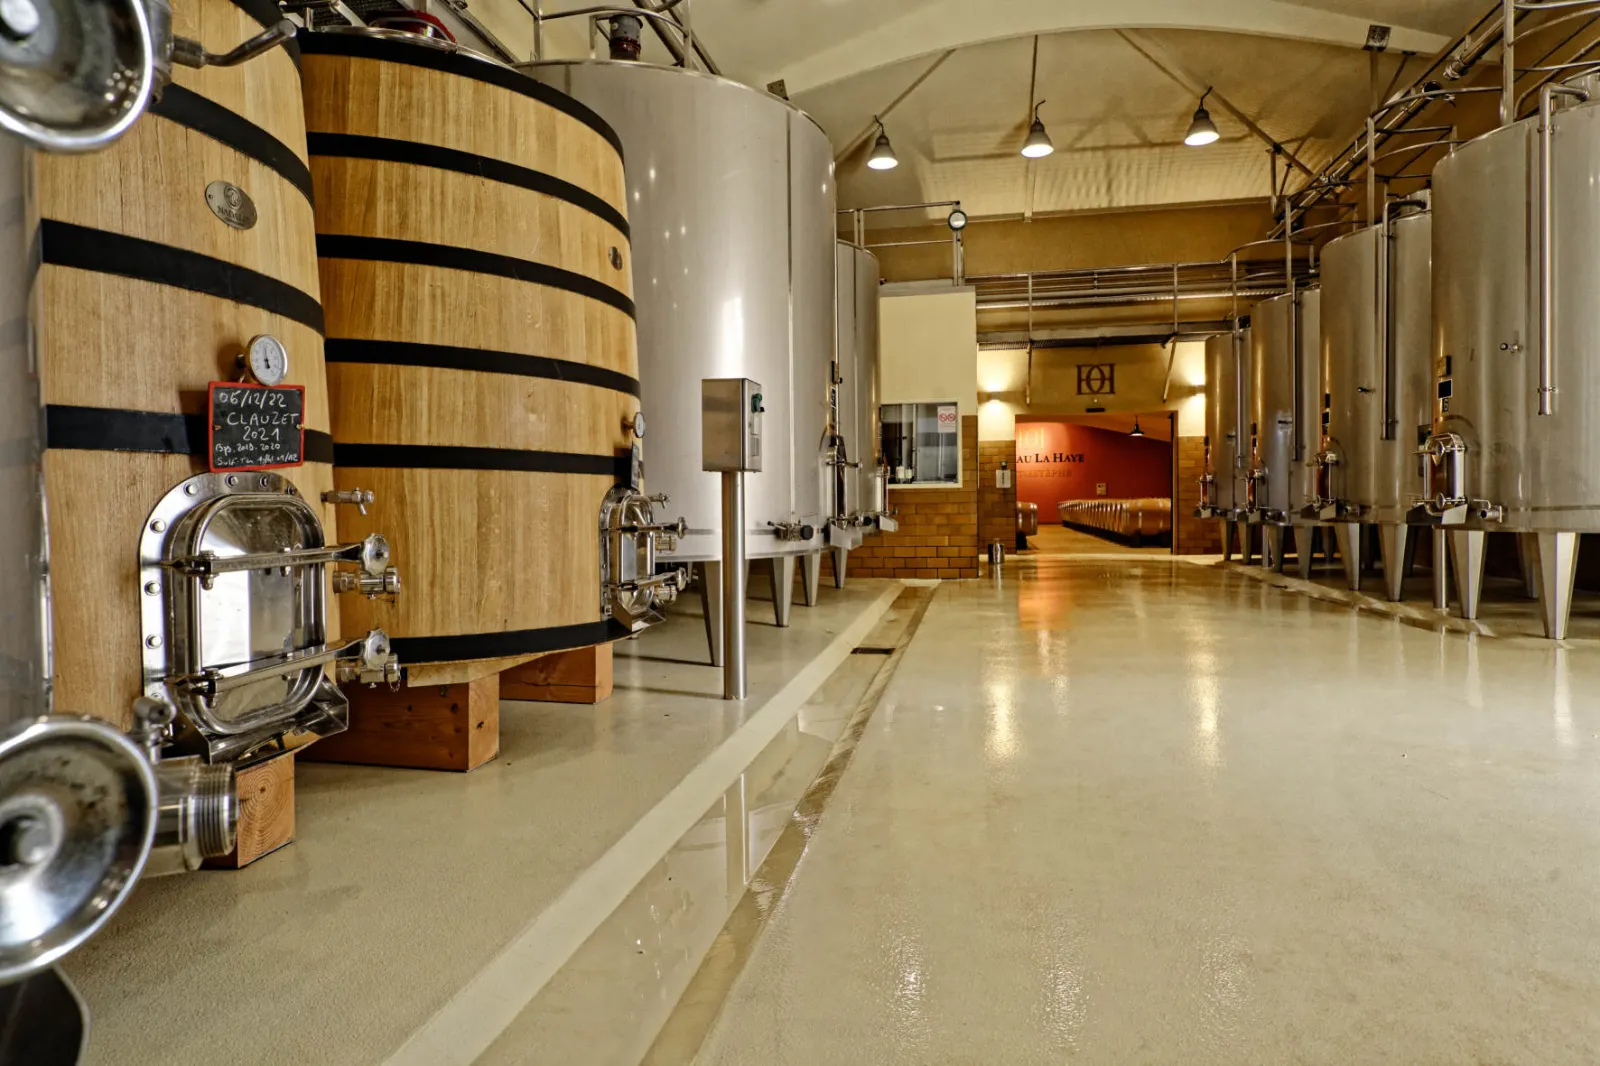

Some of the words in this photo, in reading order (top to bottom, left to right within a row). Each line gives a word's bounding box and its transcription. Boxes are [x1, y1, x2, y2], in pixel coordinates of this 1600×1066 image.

[226, 411, 300, 426] CLAUZET
[243, 426, 280, 441] 2021
[1053, 452, 1085, 463] HAYE
